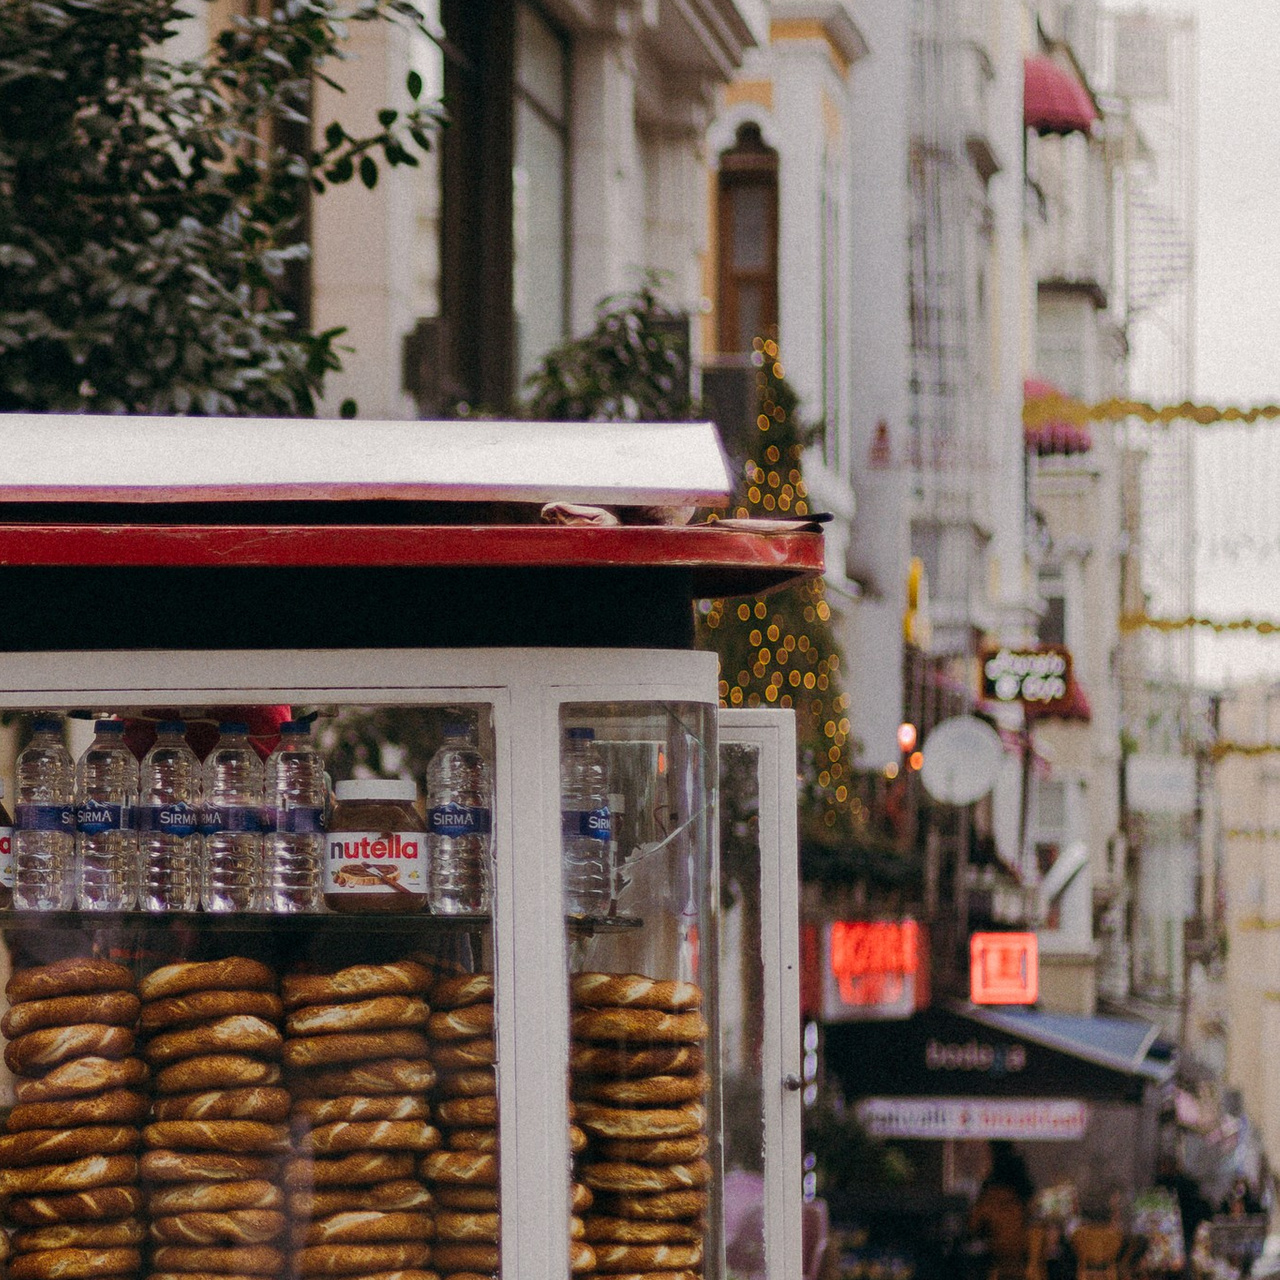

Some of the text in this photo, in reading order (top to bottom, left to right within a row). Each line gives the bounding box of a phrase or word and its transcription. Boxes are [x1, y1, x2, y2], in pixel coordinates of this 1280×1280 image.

[76, 809, 112, 824] SIRMA
[160, 811, 198, 825] SIRMA
[432, 812, 475, 827] SIRMA
[330, 834, 419, 859] nutella
